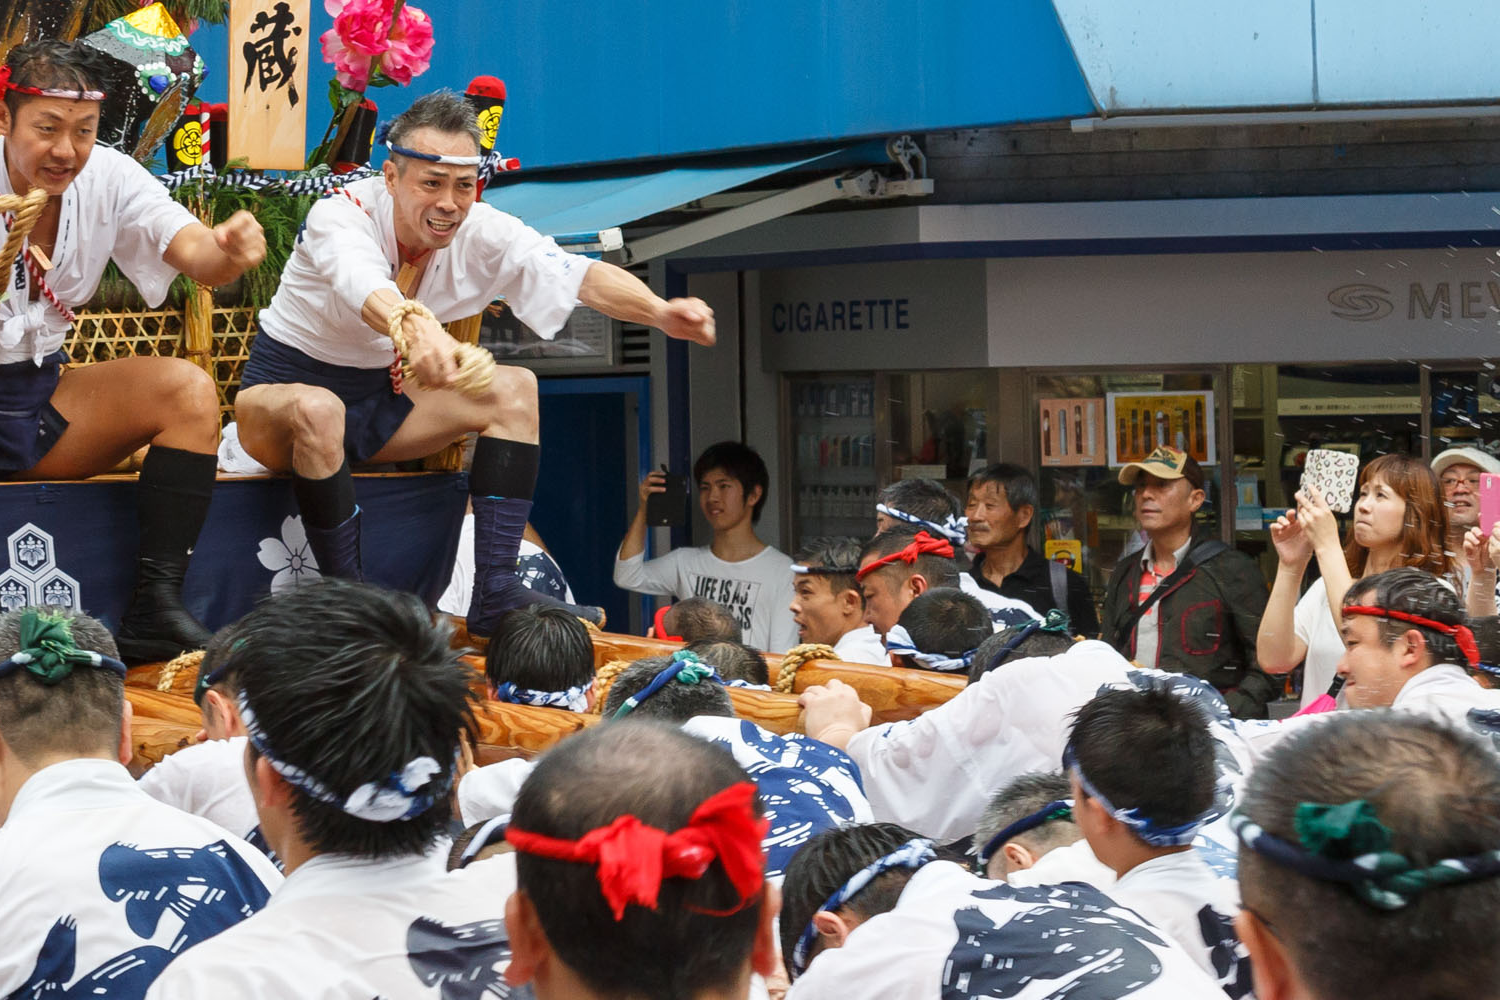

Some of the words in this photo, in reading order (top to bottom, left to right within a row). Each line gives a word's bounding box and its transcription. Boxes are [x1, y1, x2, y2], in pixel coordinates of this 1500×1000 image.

[772, 298, 910, 334] CIGARETTE
[695, 576, 718, 600] LIFE
[718, 579, 733, 603] IS
